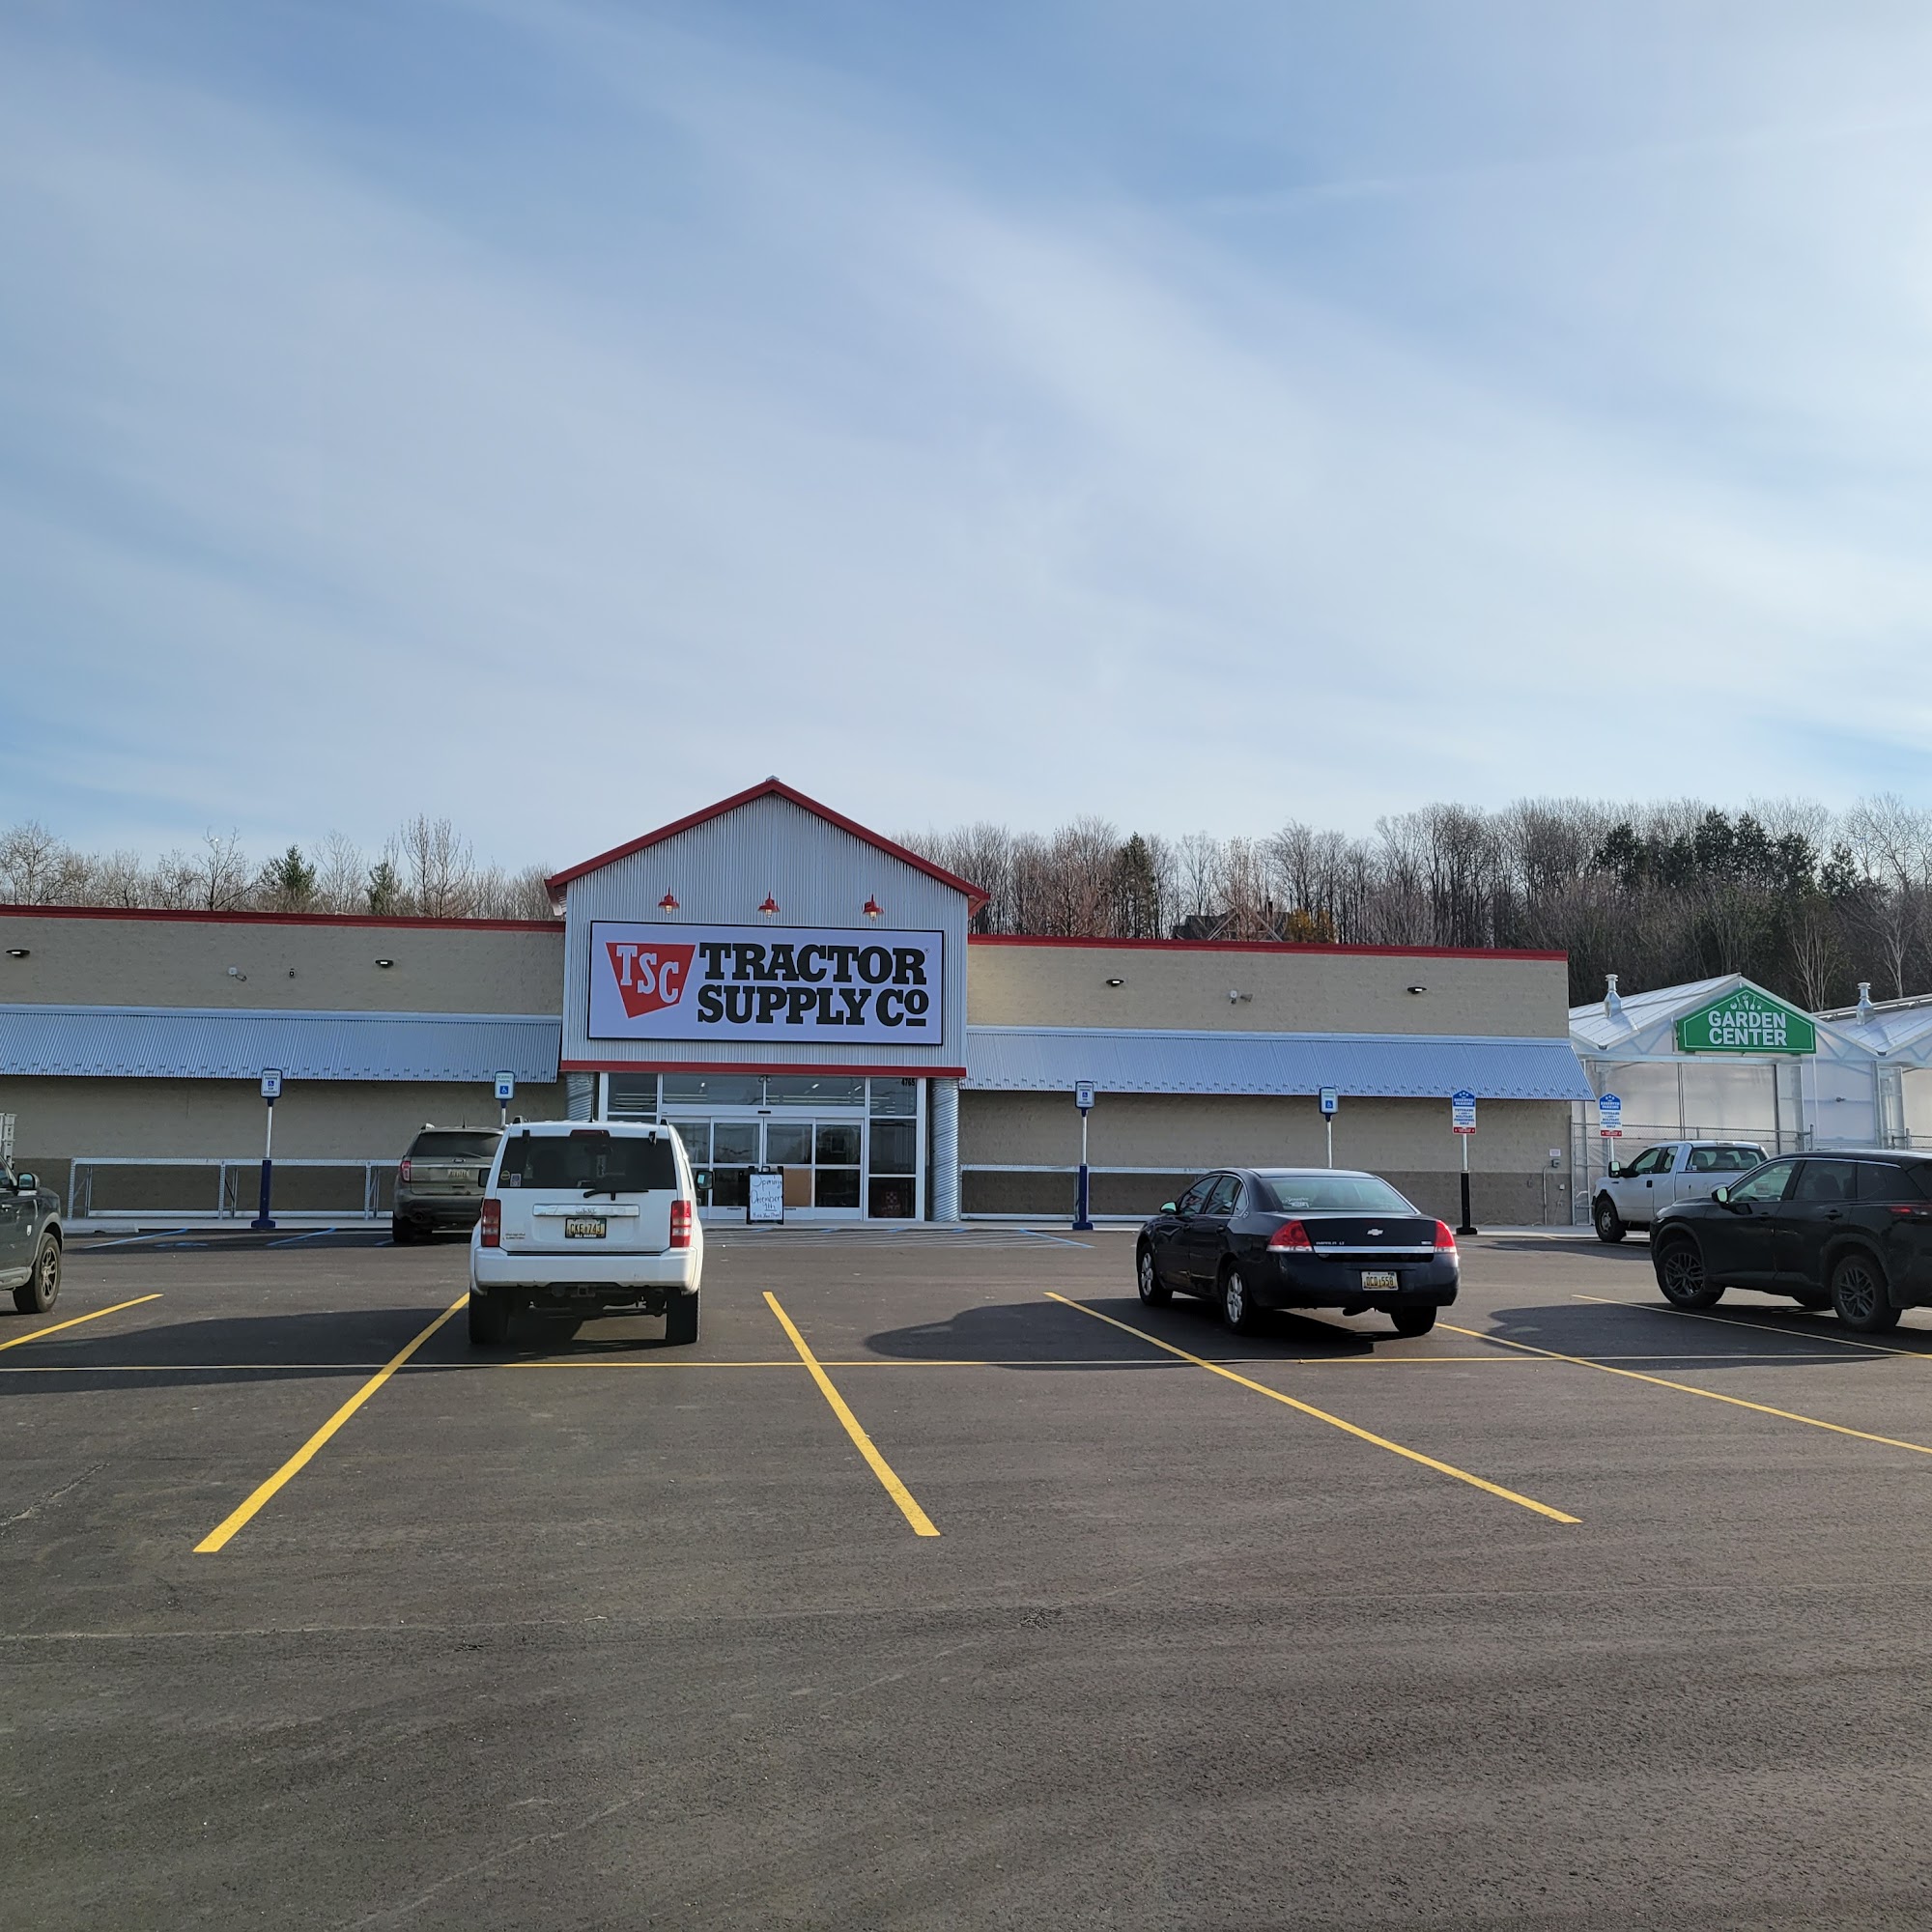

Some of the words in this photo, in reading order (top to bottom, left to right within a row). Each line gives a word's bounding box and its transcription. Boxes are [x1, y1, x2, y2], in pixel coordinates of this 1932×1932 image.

[698, 942, 927, 985] TRACTOR
[616, 945, 679, 1004] TSC
[696, 983, 872, 1026] SUPPLY
[1708, 1010, 1786, 1029] GARDEN
[1709, 1028, 1788, 1046] CENTER
[751, 1175, 781, 1192] Opening
[752, 1190, 780, 1204] December
